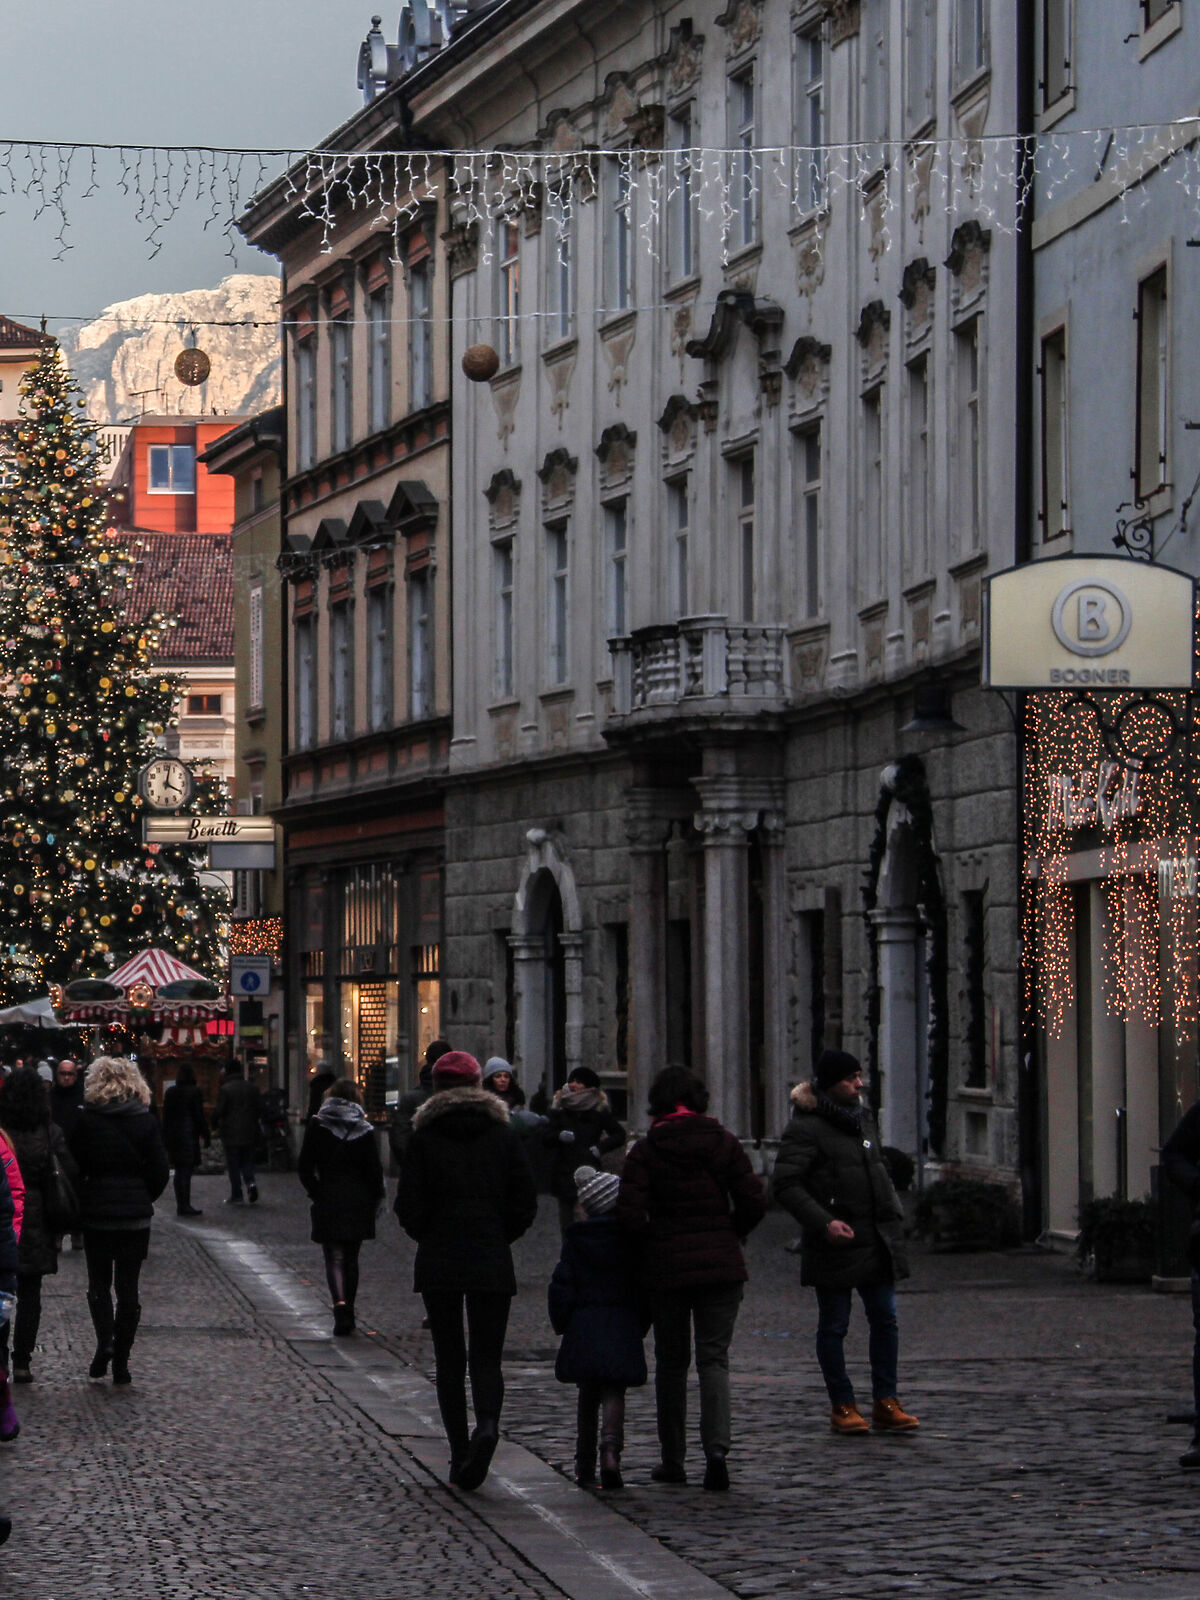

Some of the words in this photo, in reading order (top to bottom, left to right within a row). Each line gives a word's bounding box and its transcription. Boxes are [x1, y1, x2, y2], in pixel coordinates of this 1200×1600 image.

[1077, 594, 1109, 642] B
[1049, 668, 1130, 683] BOGNER
[187, 818, 240, 840] Benetti
